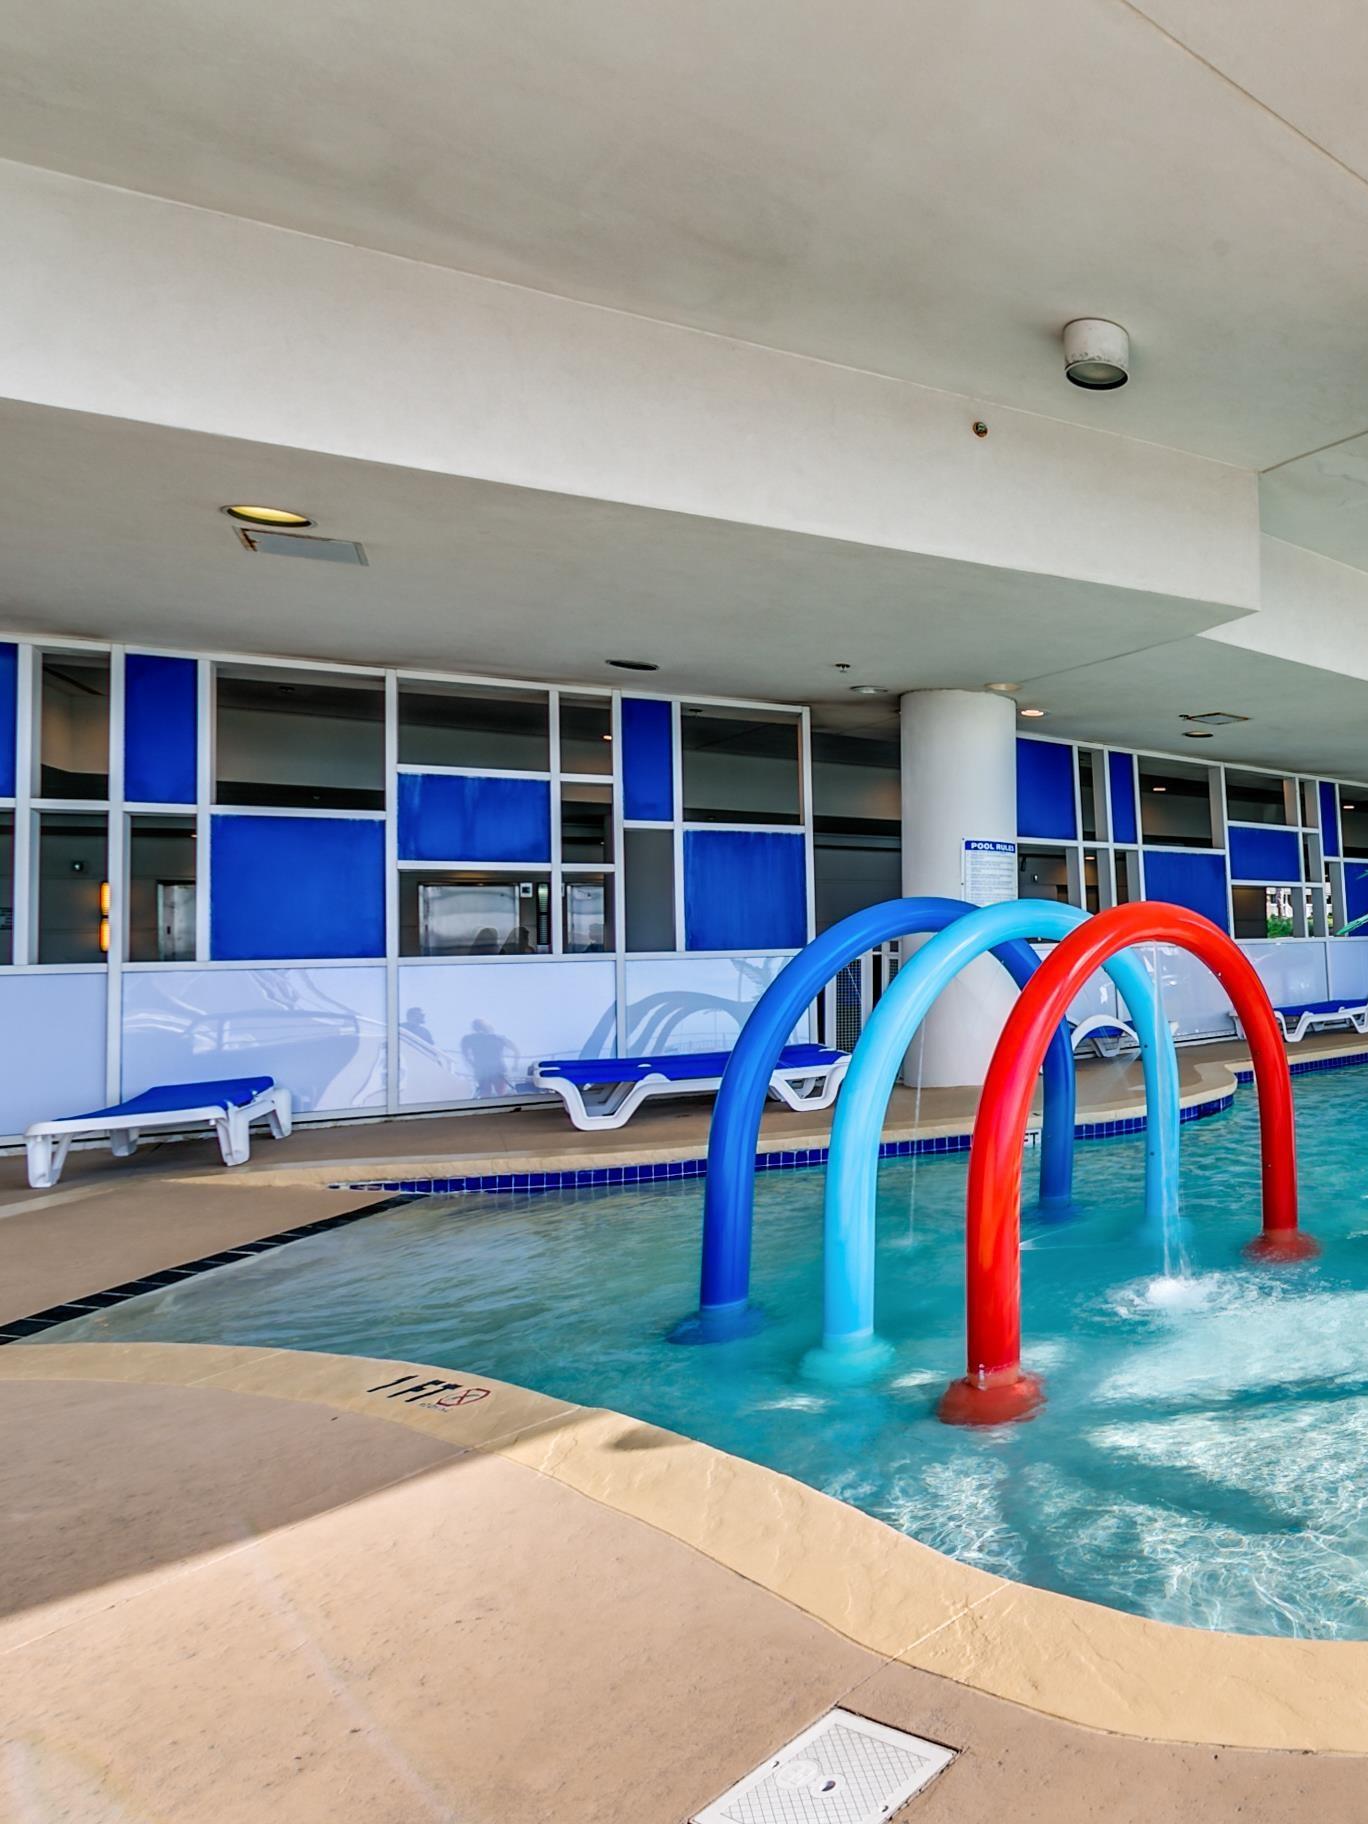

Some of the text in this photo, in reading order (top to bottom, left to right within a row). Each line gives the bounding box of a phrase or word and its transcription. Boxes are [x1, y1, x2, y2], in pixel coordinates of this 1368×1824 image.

[971, 842, 1014, 852] POOL RULES
[367, 1375, 463, 1403] 1 FT
